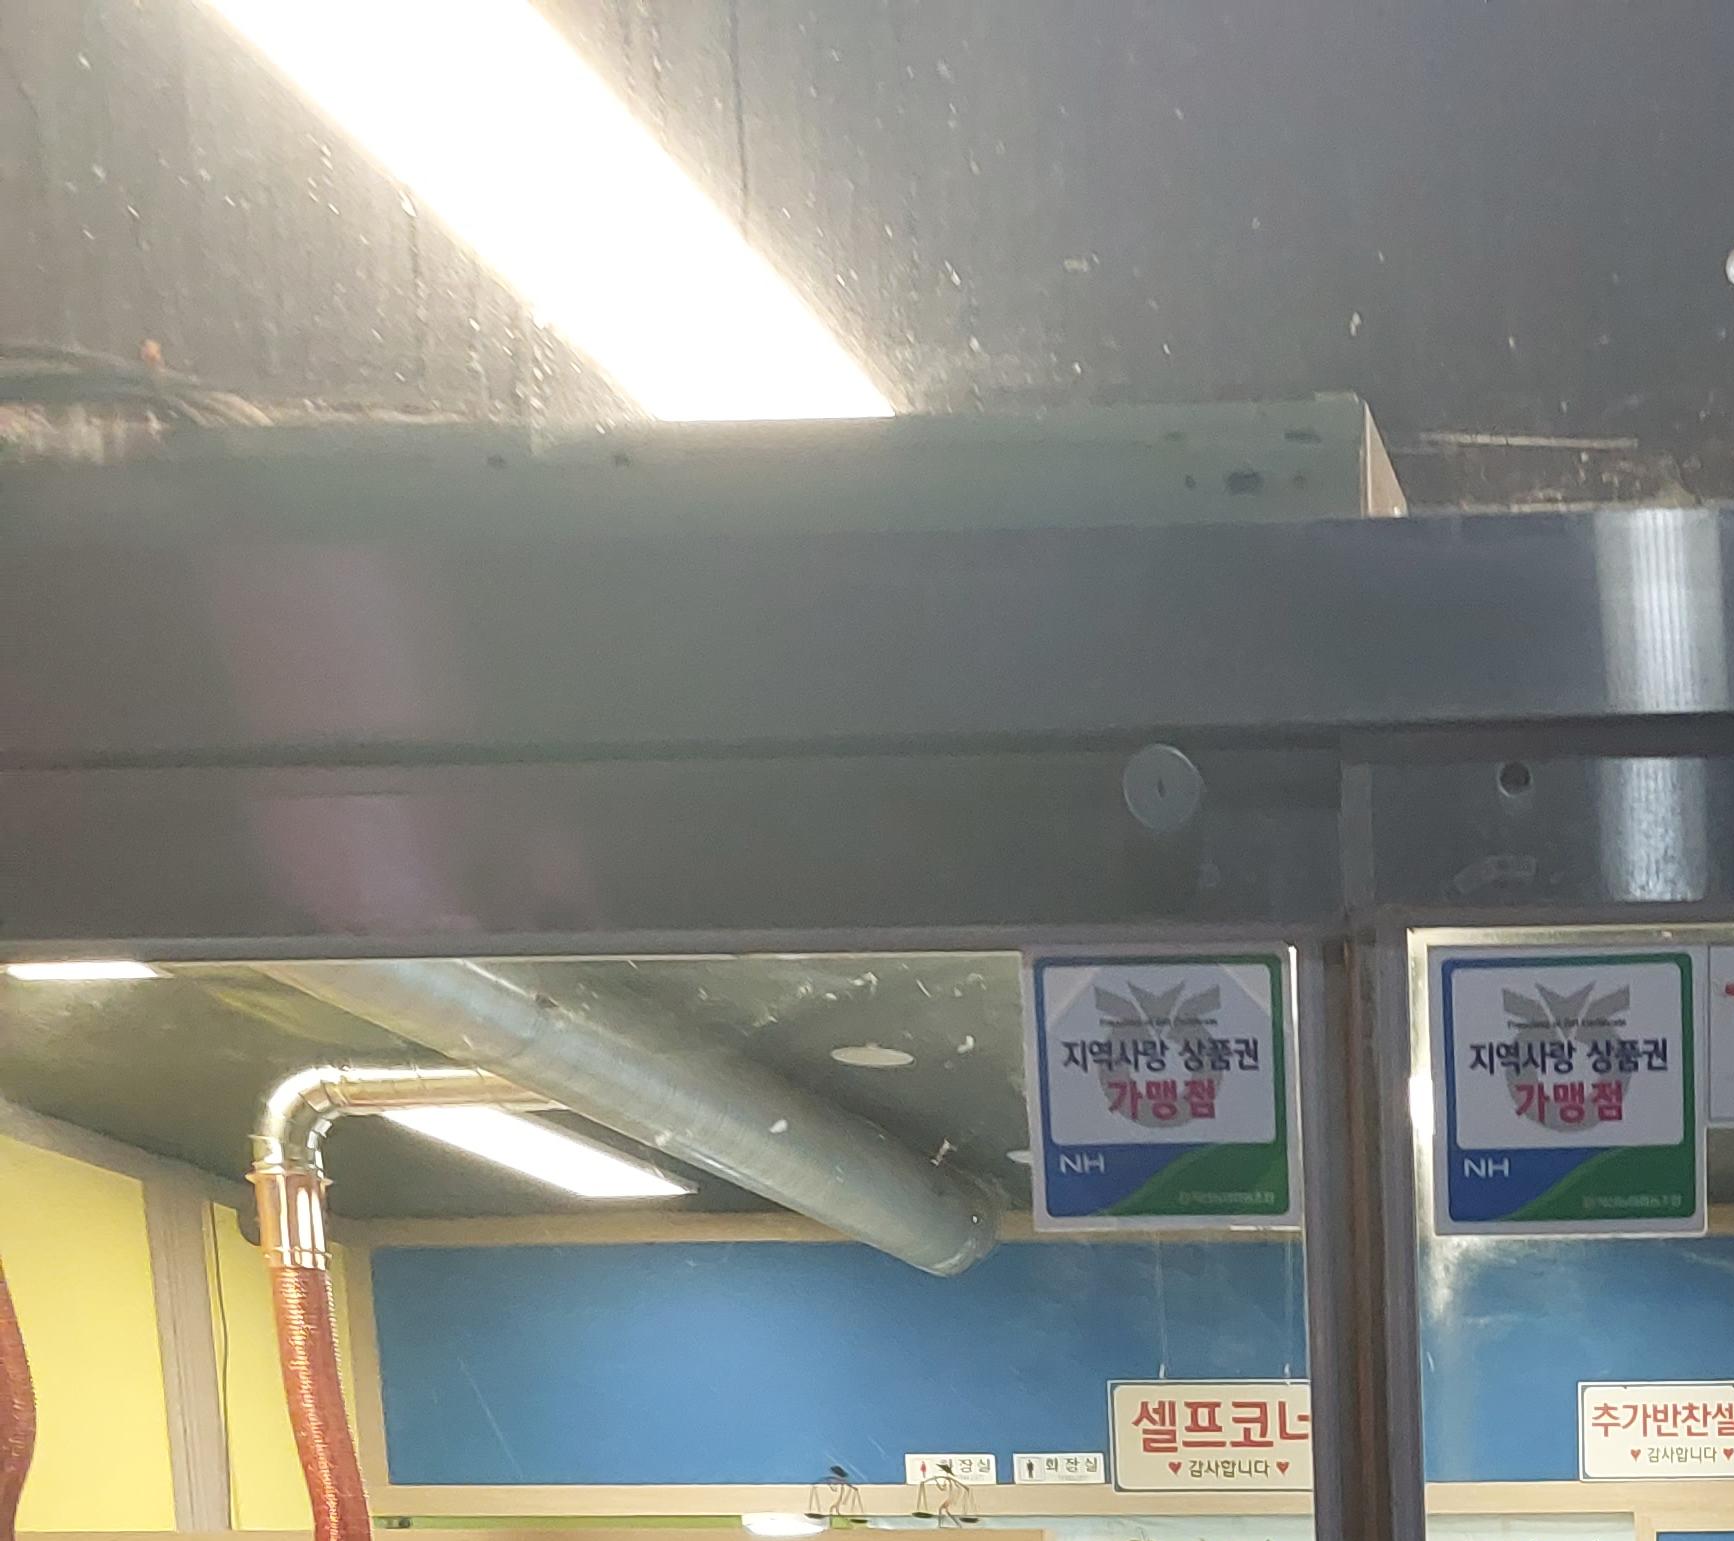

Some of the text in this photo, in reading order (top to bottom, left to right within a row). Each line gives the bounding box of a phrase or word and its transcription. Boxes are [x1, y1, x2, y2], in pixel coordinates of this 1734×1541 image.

[1062, 1037, 1259, 1073] 지역사랑 상품권
[1469, 1037, 1668, 1075] 지역사랑 상품권
[1107, 1078, 1216, 1121] 가맹점
[1514, 1079, 1624, 1123] 가맹점
[1060, 1153, 1105, 1175] NH
[1464, 1158, 1510, 1179] NH
[1045, 1456, 1098, 1473] 화장실
[1647, 1446, 1718, 1464] 감사합니다
[1188, 1460, 1271, 1479] 감사합니다
